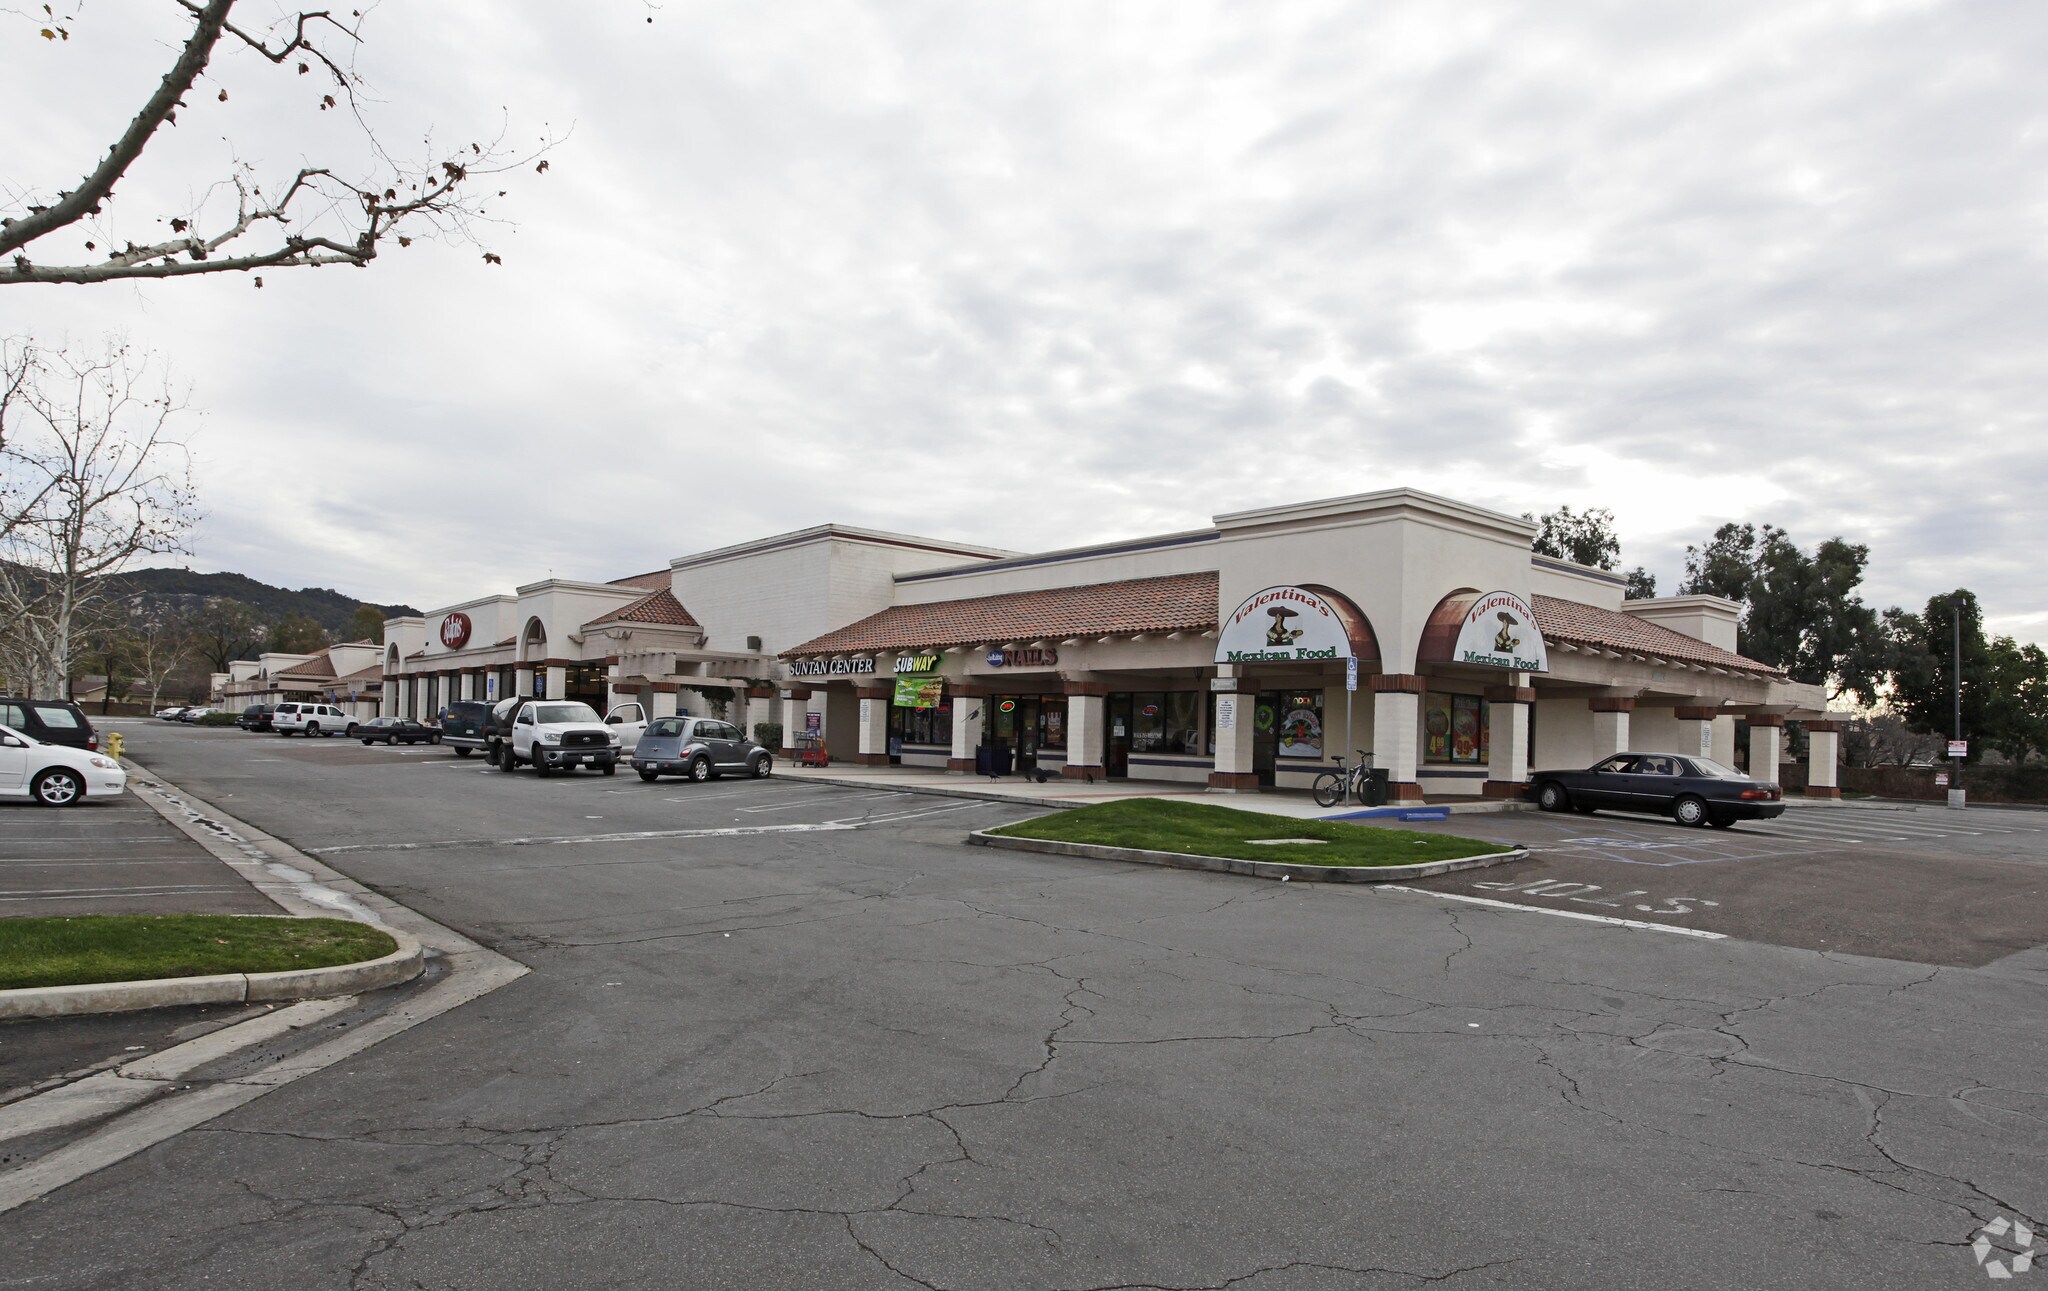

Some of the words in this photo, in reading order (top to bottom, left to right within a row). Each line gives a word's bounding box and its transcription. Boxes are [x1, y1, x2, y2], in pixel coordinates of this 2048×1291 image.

[1235, 588, 1329, 624] Valentina's
[1471, 596, 1537, 631] Valentina's
[1003, 647, 1058, 666] NAILS
[1227, 649, 1291, 662] Mexican
[1295, 646, 1337, 660] Food
[1463, 650, 1510, 667] Mexican
[1513, 656, 1540, 670] Food
[789, 660, 828, 676] SUNTAN
[829, 658, 874, 674] CENTER
[893, 655, 938, 673] SUBWAY
